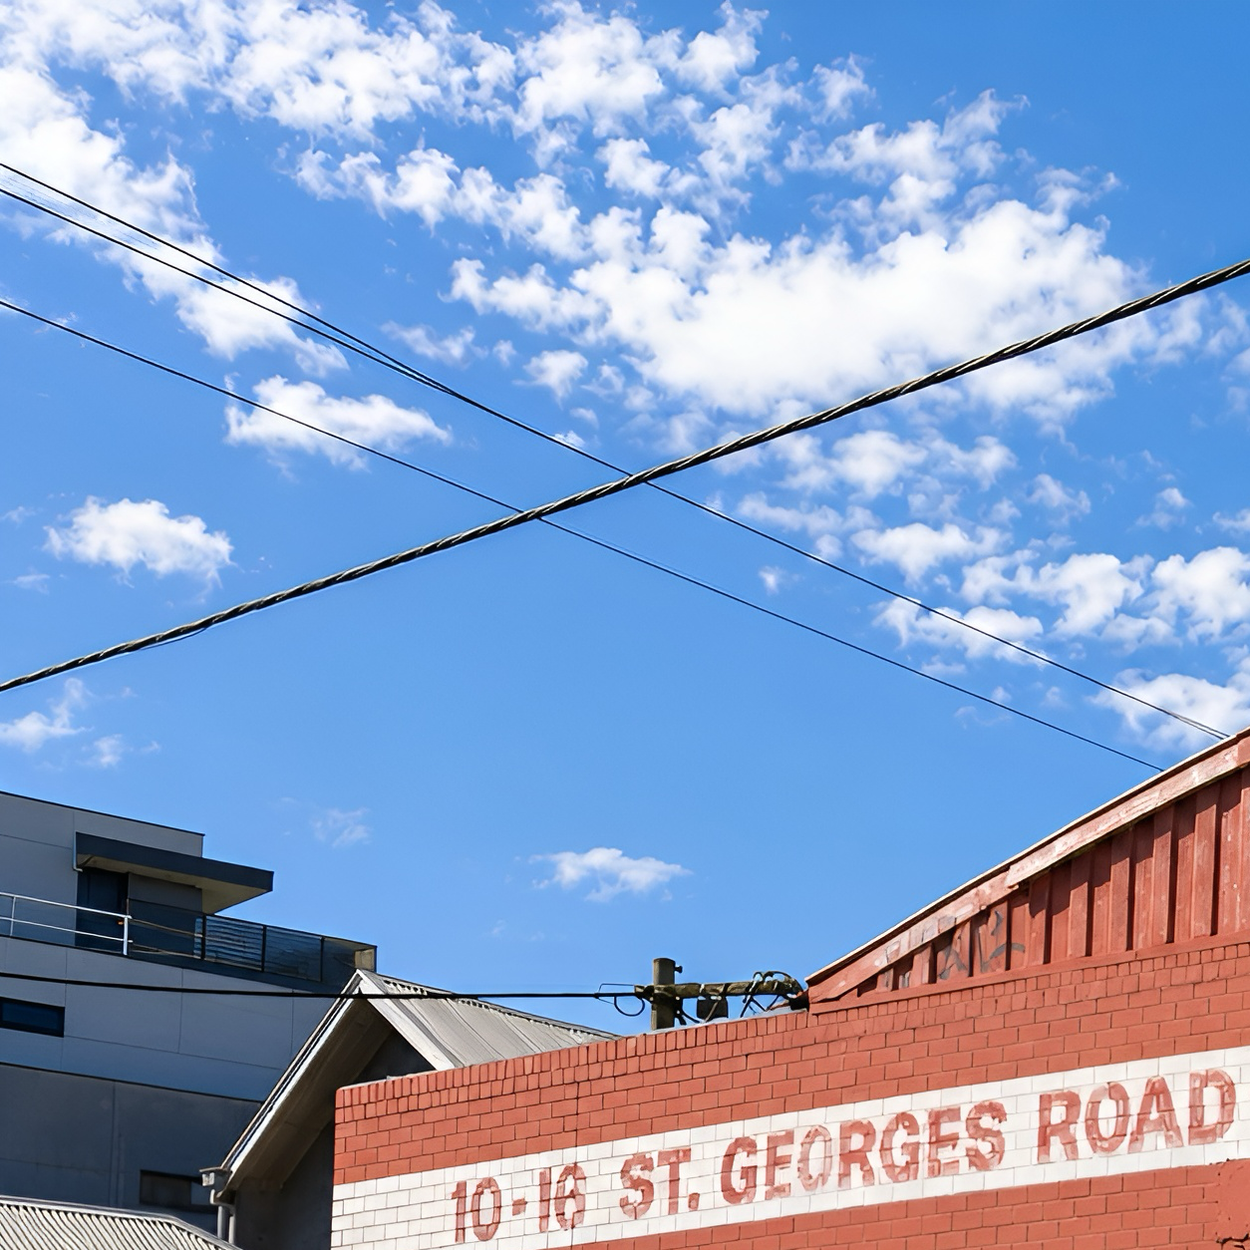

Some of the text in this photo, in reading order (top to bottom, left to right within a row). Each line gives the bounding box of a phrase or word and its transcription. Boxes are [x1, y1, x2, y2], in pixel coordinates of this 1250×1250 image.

[619, 1147, 700, 1220] ST.
[720, 1100, 1008, 1205] GEORGES
[1036, 1068, 1237, 1164] ROAD
